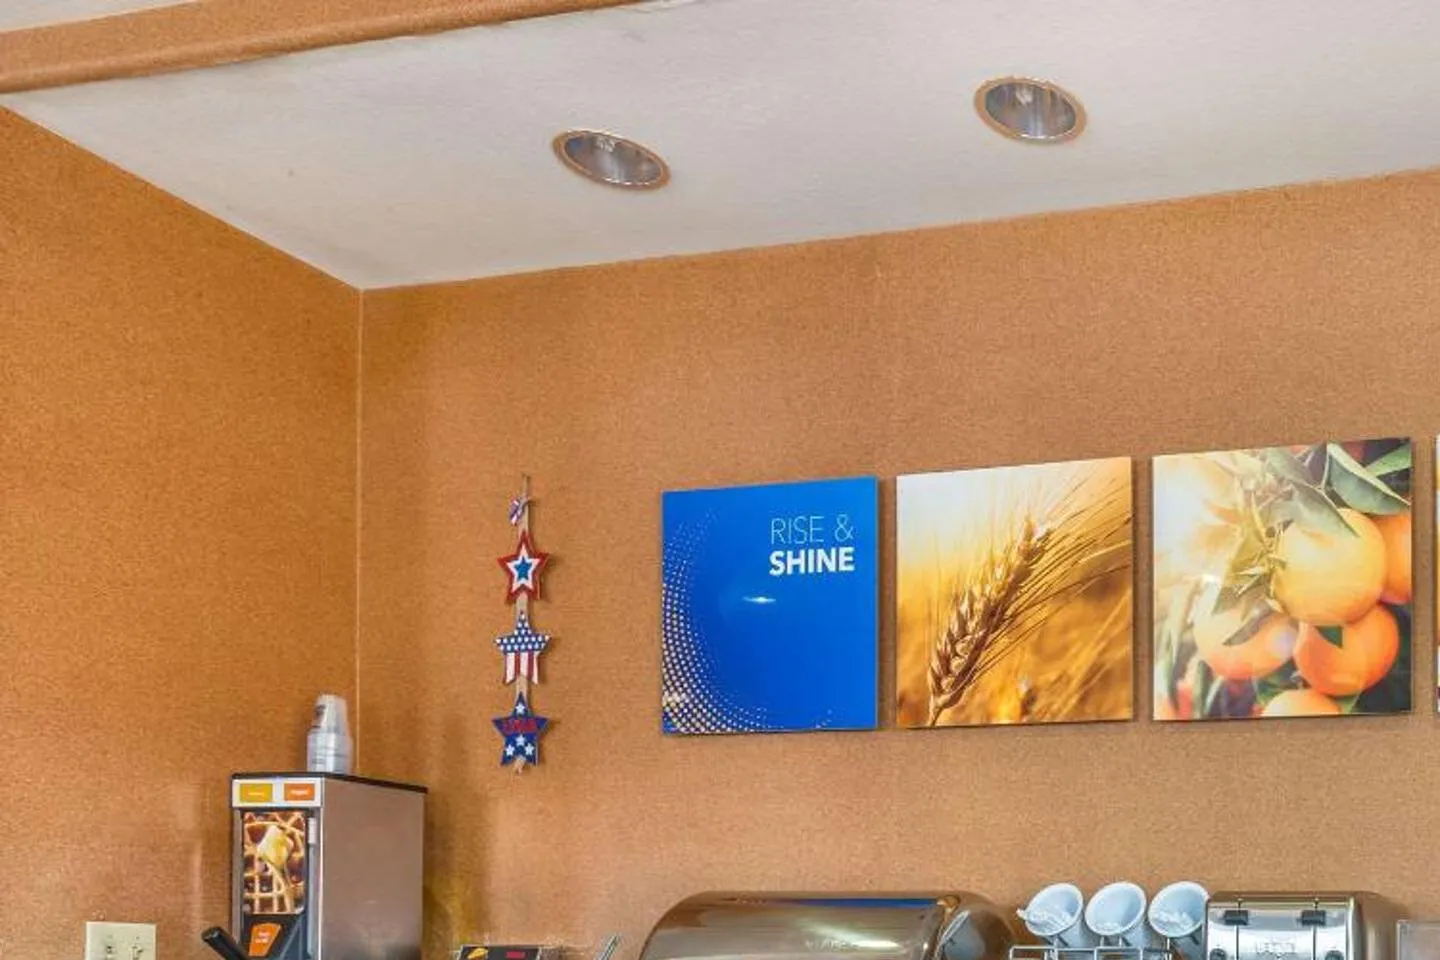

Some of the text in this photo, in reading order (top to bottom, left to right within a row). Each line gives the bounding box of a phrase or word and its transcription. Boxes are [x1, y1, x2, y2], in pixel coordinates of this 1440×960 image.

[770, 513, 854, 545] RISE &
[769, 546, 856, 577] SHINE
